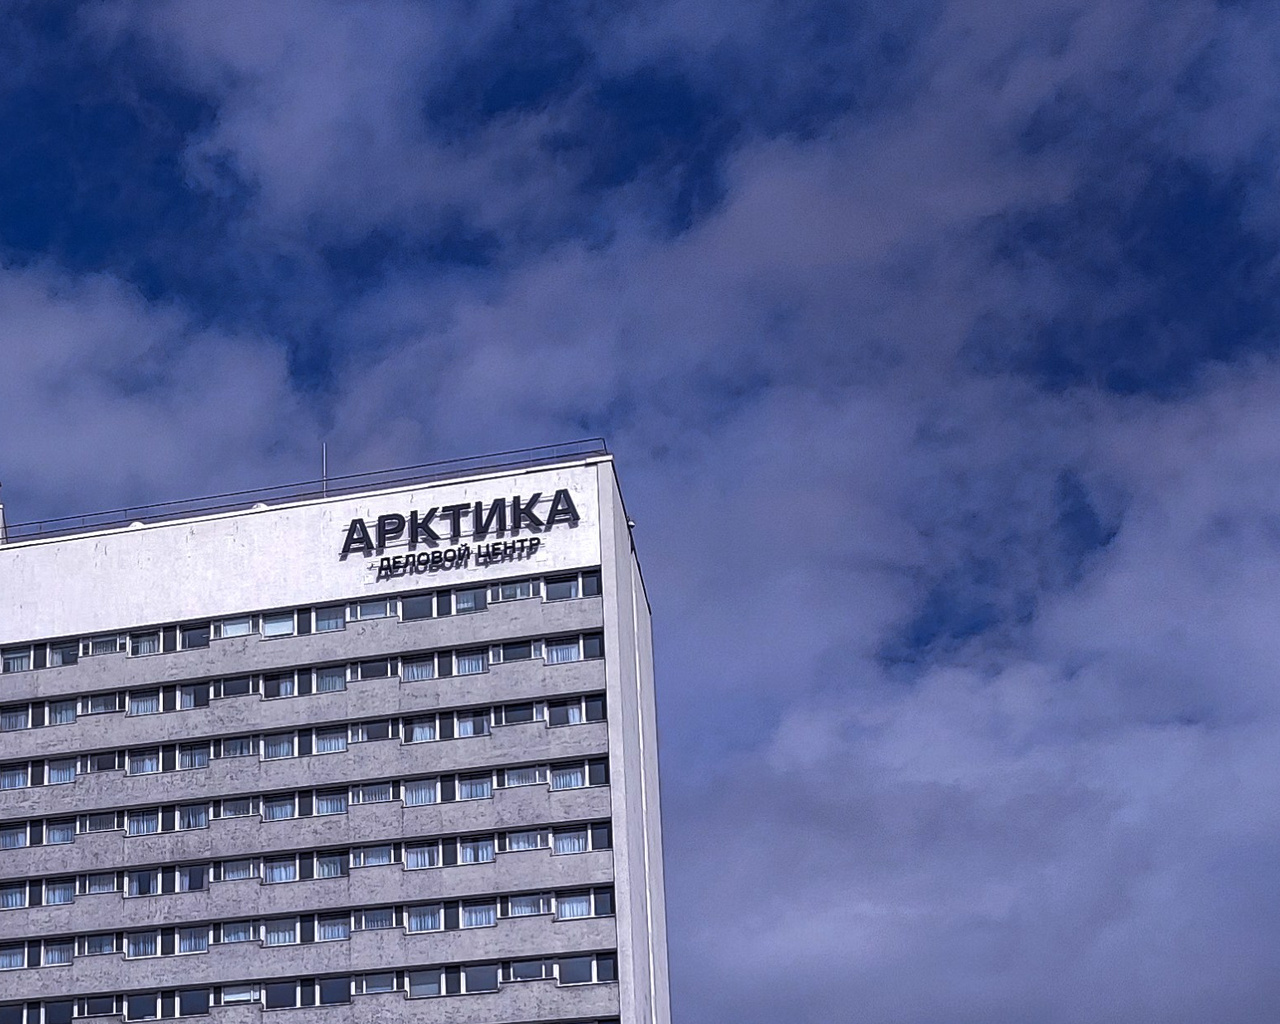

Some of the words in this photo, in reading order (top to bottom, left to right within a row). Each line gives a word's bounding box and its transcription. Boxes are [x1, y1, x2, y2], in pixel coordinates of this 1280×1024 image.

[341, 488, 580, 555] АРКТИКА
[377, 543, 471, 575] ДЕЛОВОЙ
[477, 537, 541, 562] ЦЕНТР
